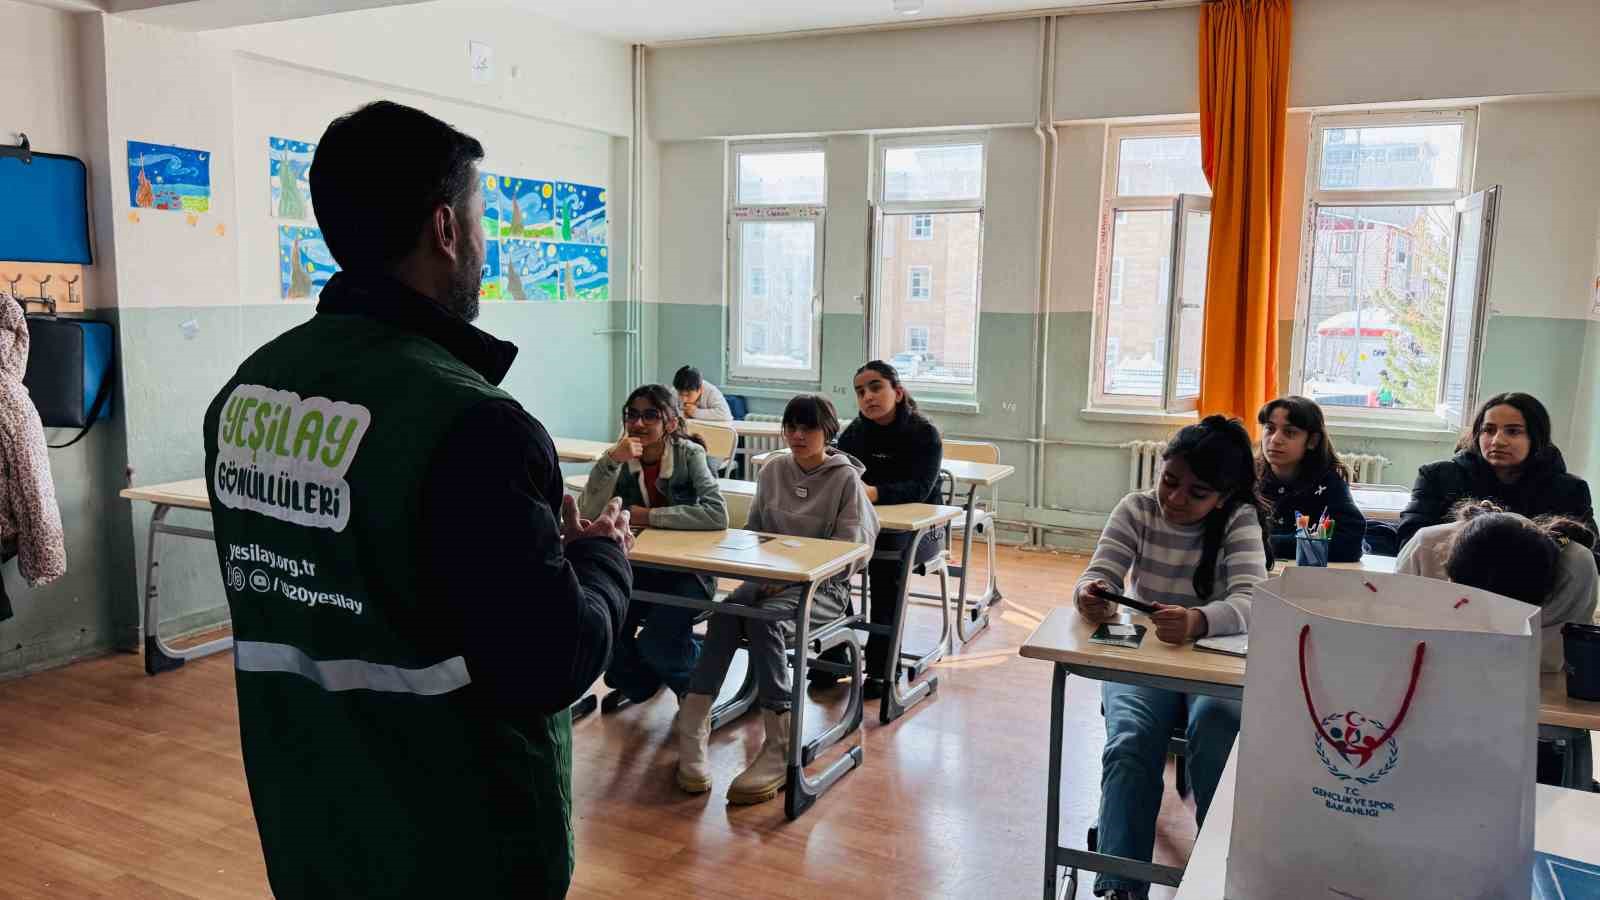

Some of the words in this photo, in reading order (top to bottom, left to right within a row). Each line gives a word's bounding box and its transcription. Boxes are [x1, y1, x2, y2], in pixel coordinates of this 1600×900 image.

[222, 396, 358, 468] YEŞİLAY
[218, 461, 340, 518] GÖNÜLLÜLERİ
[229, 543, 316, 577] yesilay.org.tr
